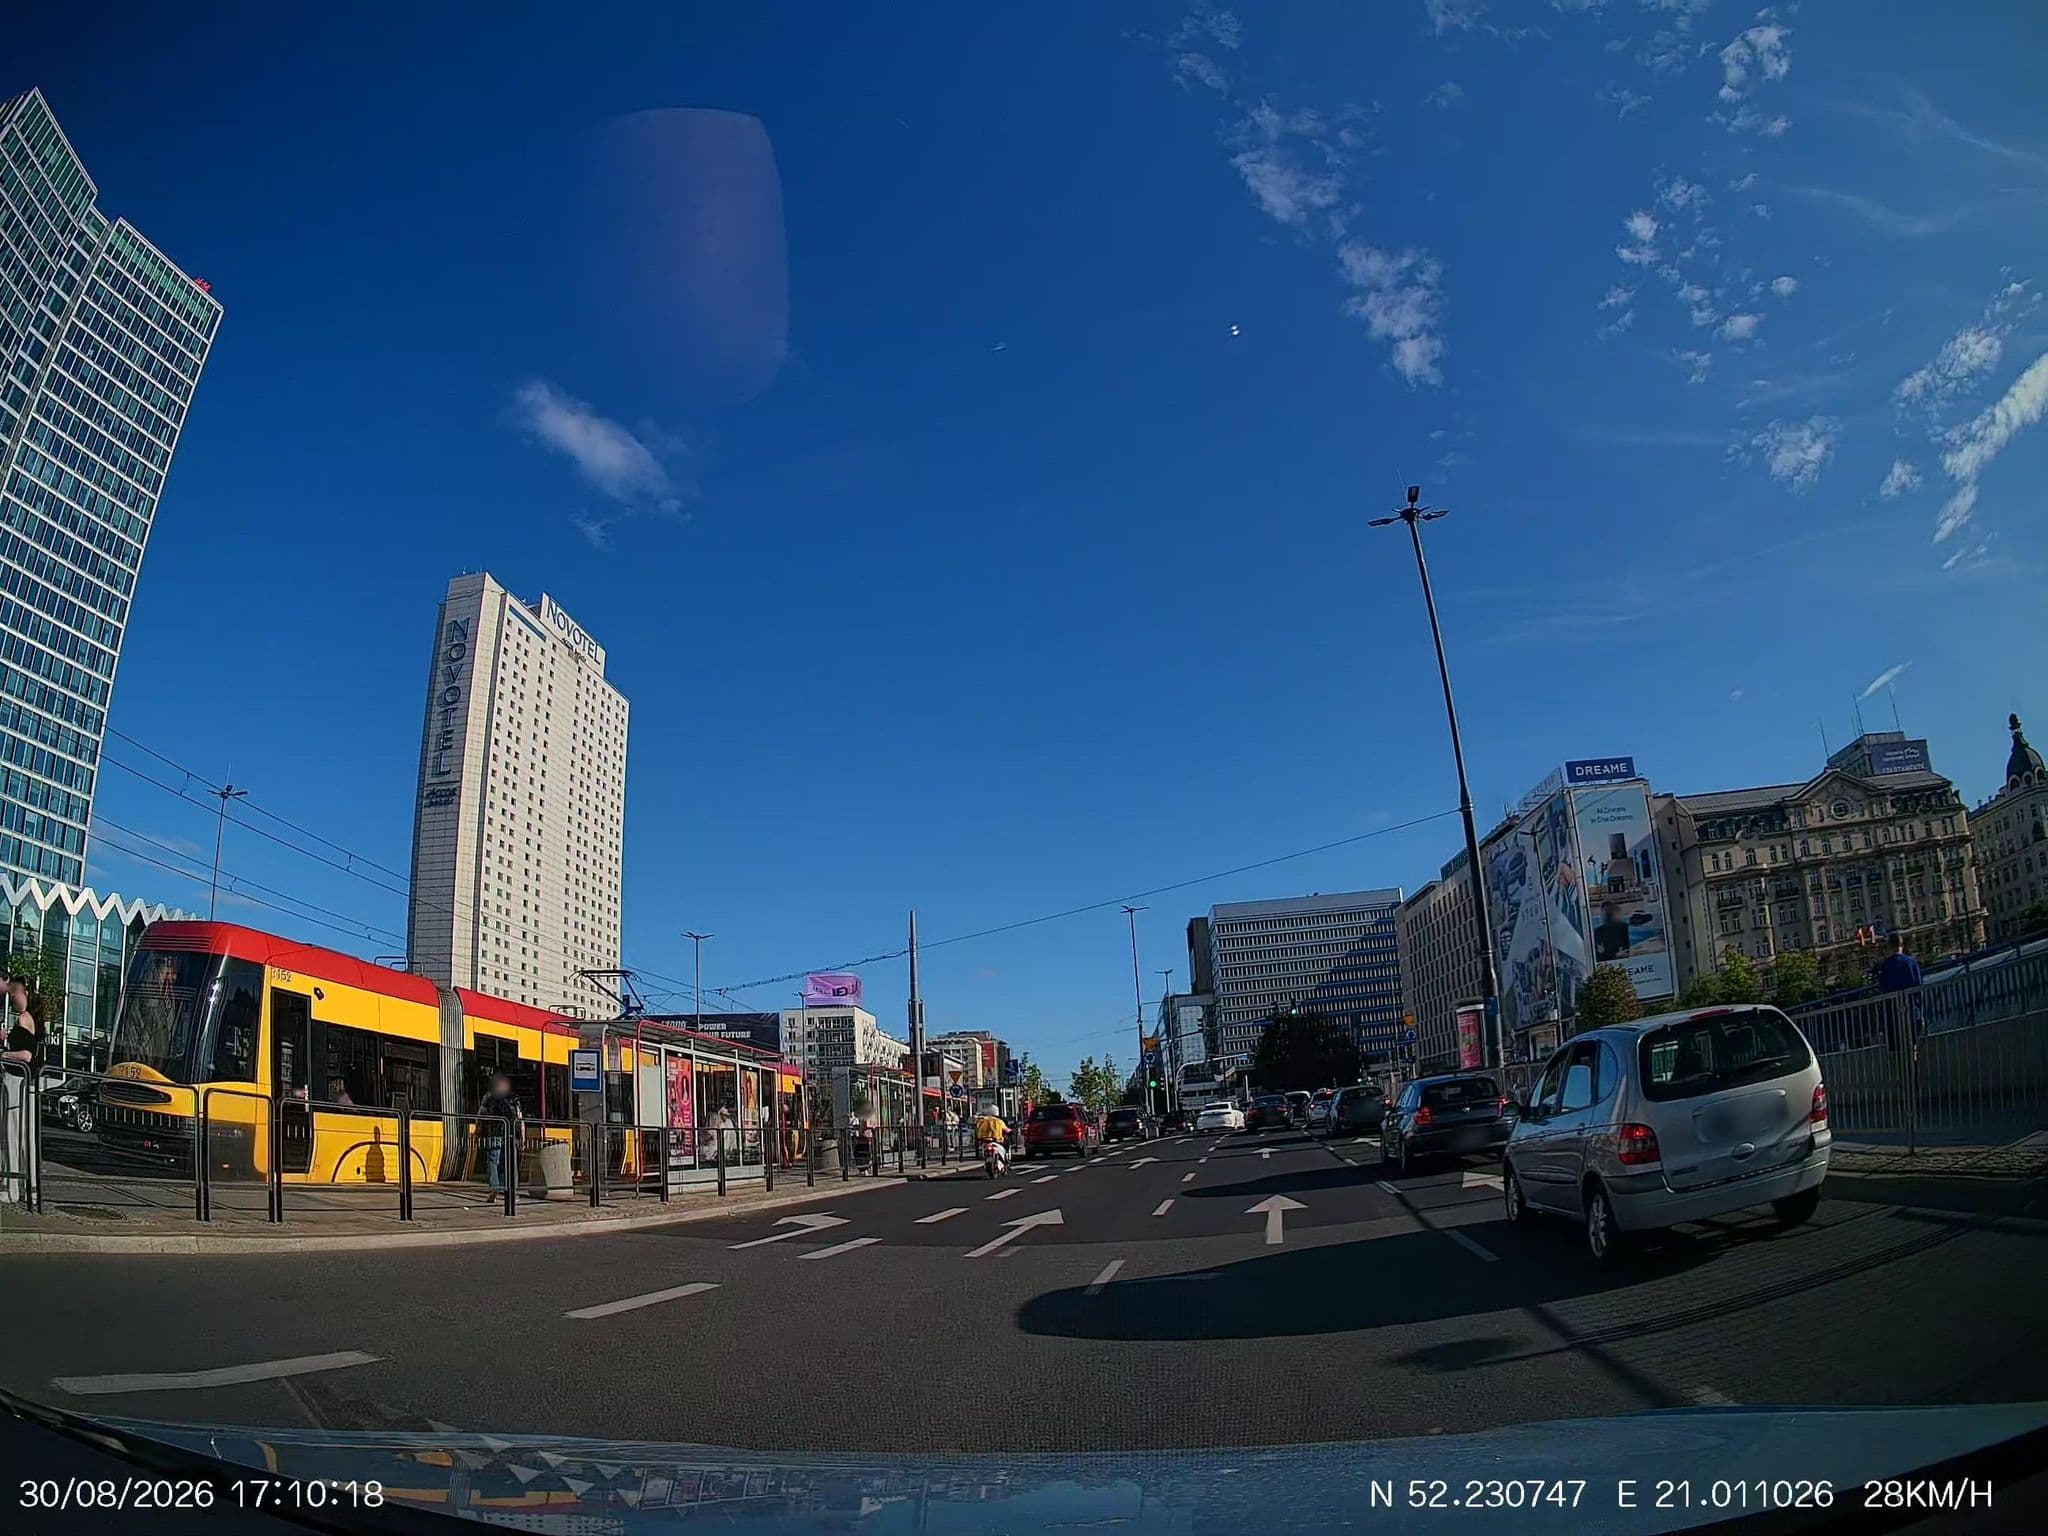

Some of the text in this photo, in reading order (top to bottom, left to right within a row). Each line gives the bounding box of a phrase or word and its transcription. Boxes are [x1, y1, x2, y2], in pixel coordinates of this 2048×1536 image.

[547, 598, 601, 665] NOVOTEL
[436, 618, 470, 776] NOVOTEL
[1575, 763, 1628, 776] DREAME
